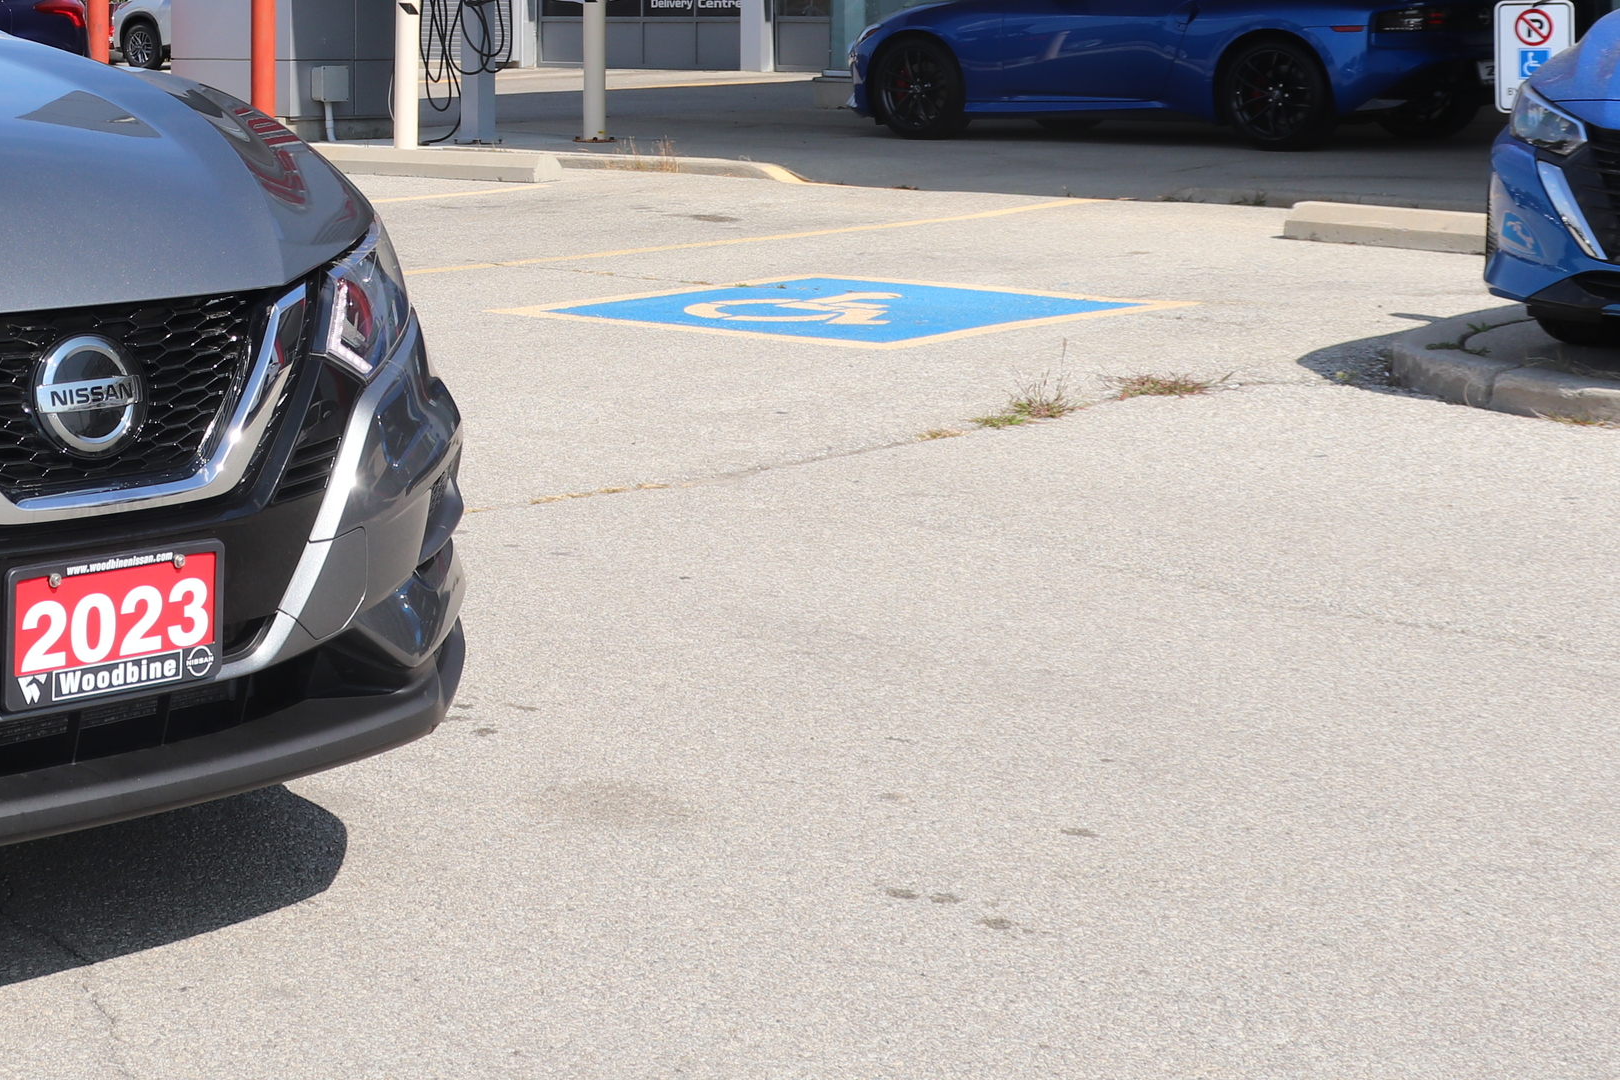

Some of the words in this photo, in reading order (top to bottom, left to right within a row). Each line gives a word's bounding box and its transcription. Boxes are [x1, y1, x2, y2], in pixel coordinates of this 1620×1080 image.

[50, 382, 134, 407] NISSAN
[66, 552, 174, 575] www.woodbinenissan.com
[20, 577, 209, 673] 2023
[186, 654, 215, 667] NISSAN
[59, 657, 177, 695] Woodbine
